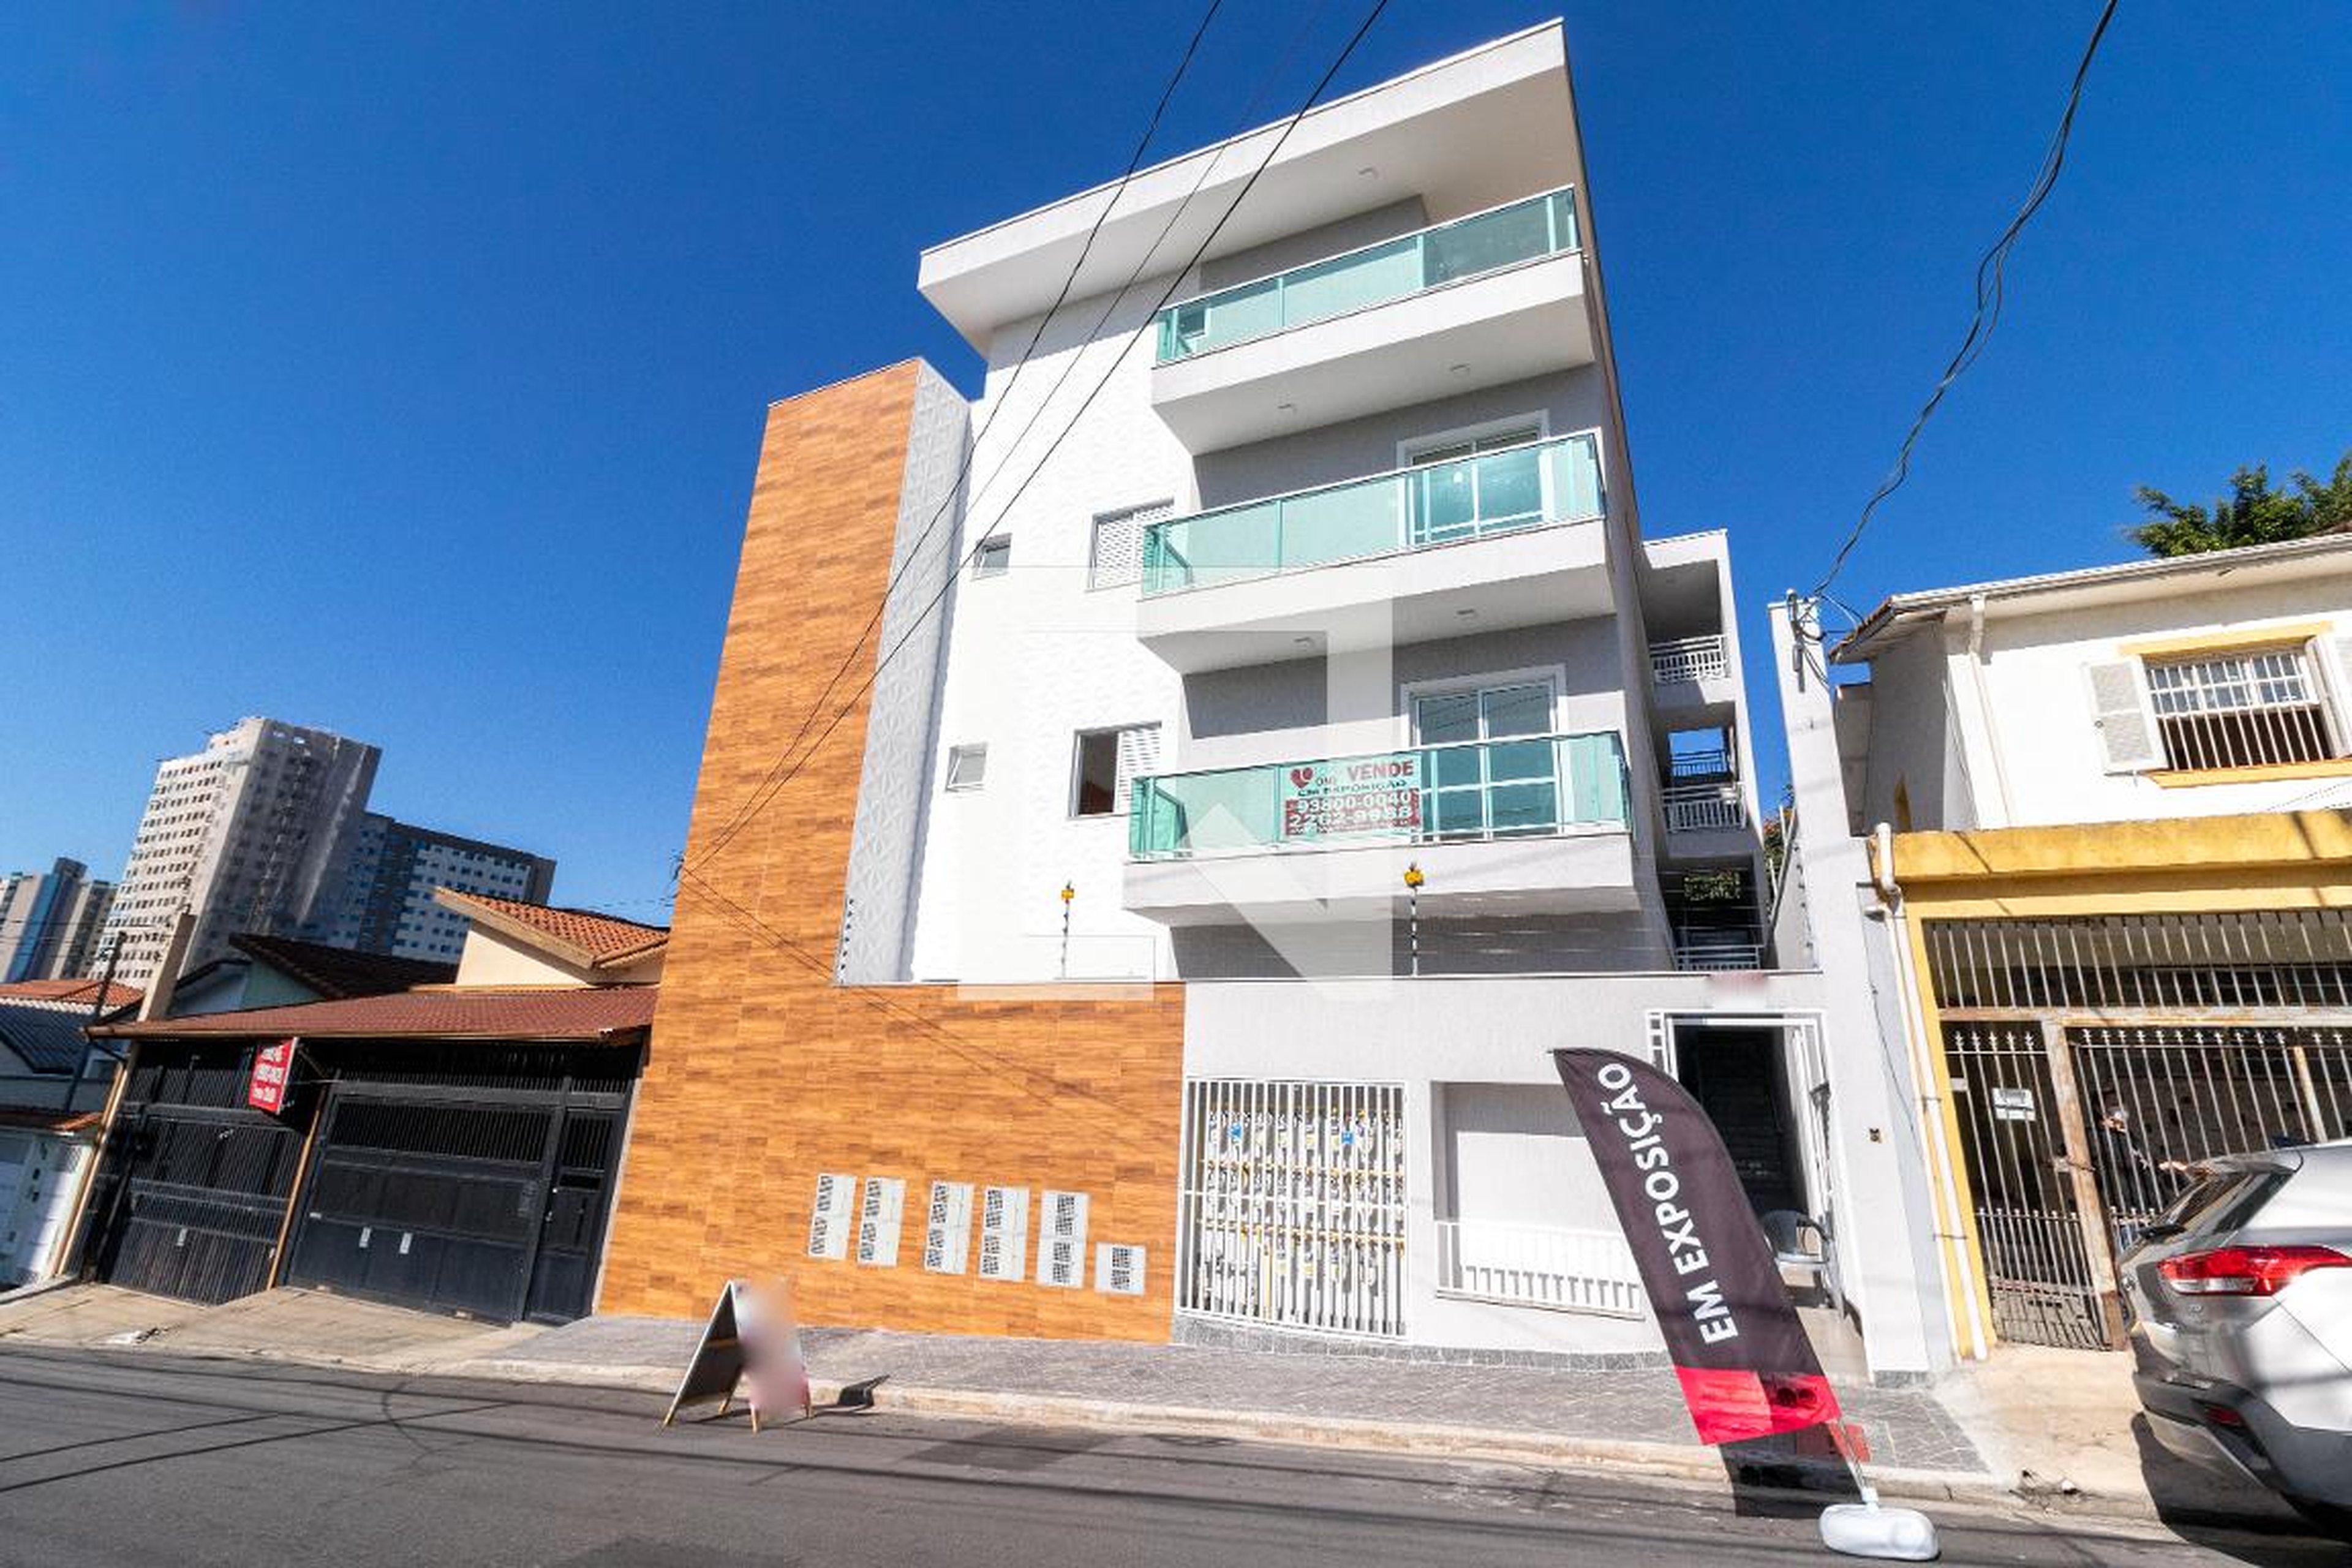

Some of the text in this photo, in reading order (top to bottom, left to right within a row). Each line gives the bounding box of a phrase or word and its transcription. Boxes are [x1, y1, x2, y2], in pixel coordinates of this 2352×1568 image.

[1347, 760, 1414, 781] VENDE
[1597, 1063, 1738, 1343] EM EXPOSIÇÃO
